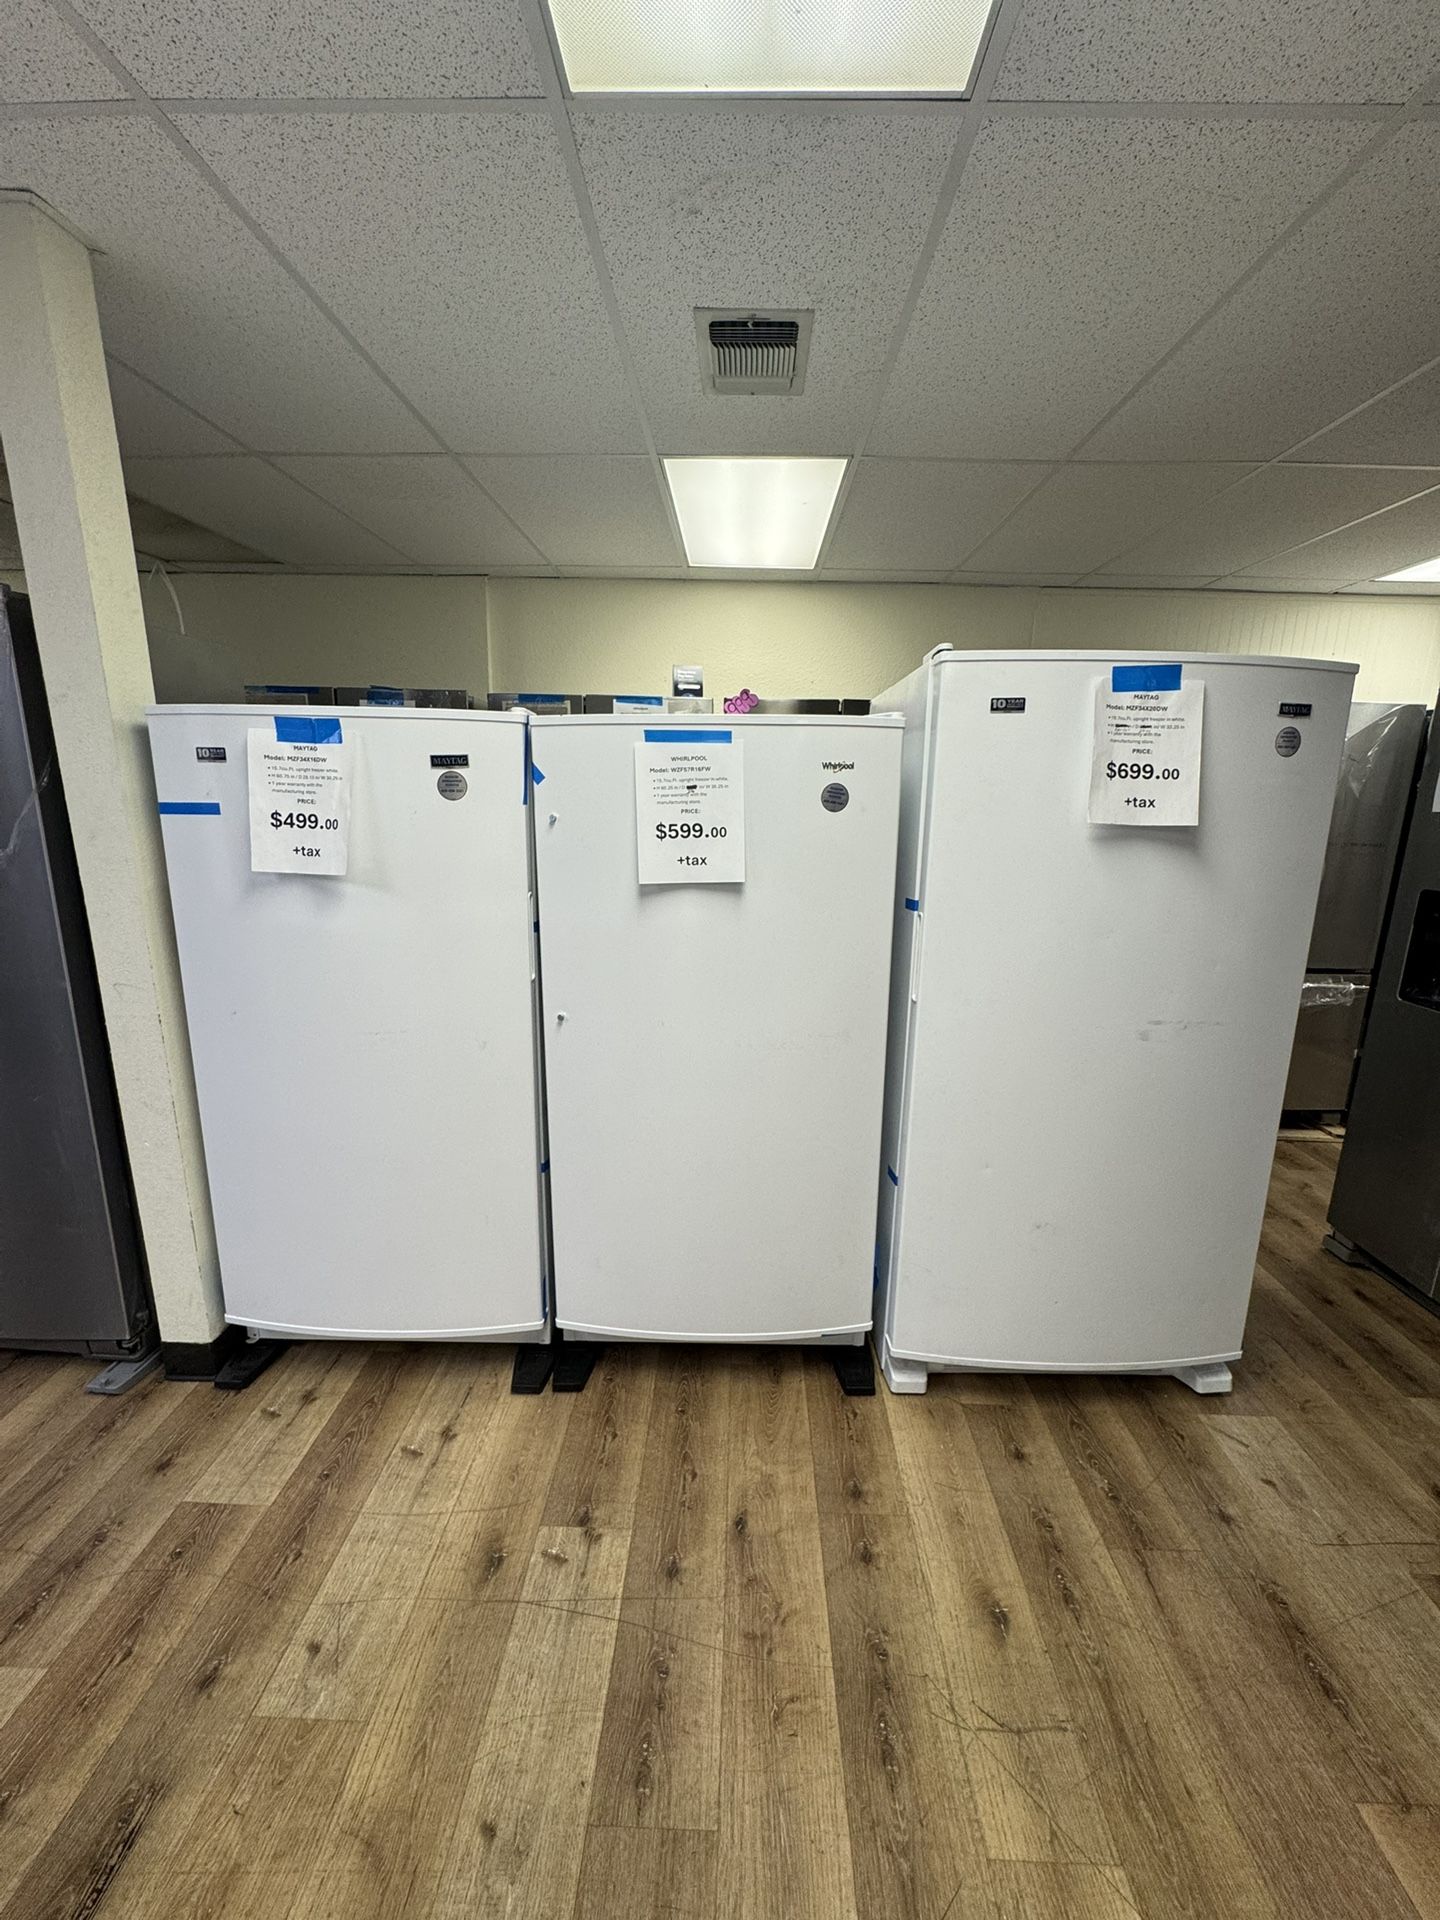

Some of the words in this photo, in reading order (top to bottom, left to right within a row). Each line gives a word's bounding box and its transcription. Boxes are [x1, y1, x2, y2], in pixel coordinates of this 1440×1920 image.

[992, 699, 1006, 709] 10
[197, 748, 209, 758] 10
[263, 754, 285, 762] Model:
[432, 756, 467, 765] MAYTAG
[821, 761, 854, 773] Whirlpool
[1106, 759, 1180, 781] $699.00
[1124, 796, 1156, 808] +tax
[270, 809, 339, 830] $499.00
[656, 821, 727, 842] $599.00
[293, 846, 321, 857] +tax
[677, 855, 707, 866] +tax
